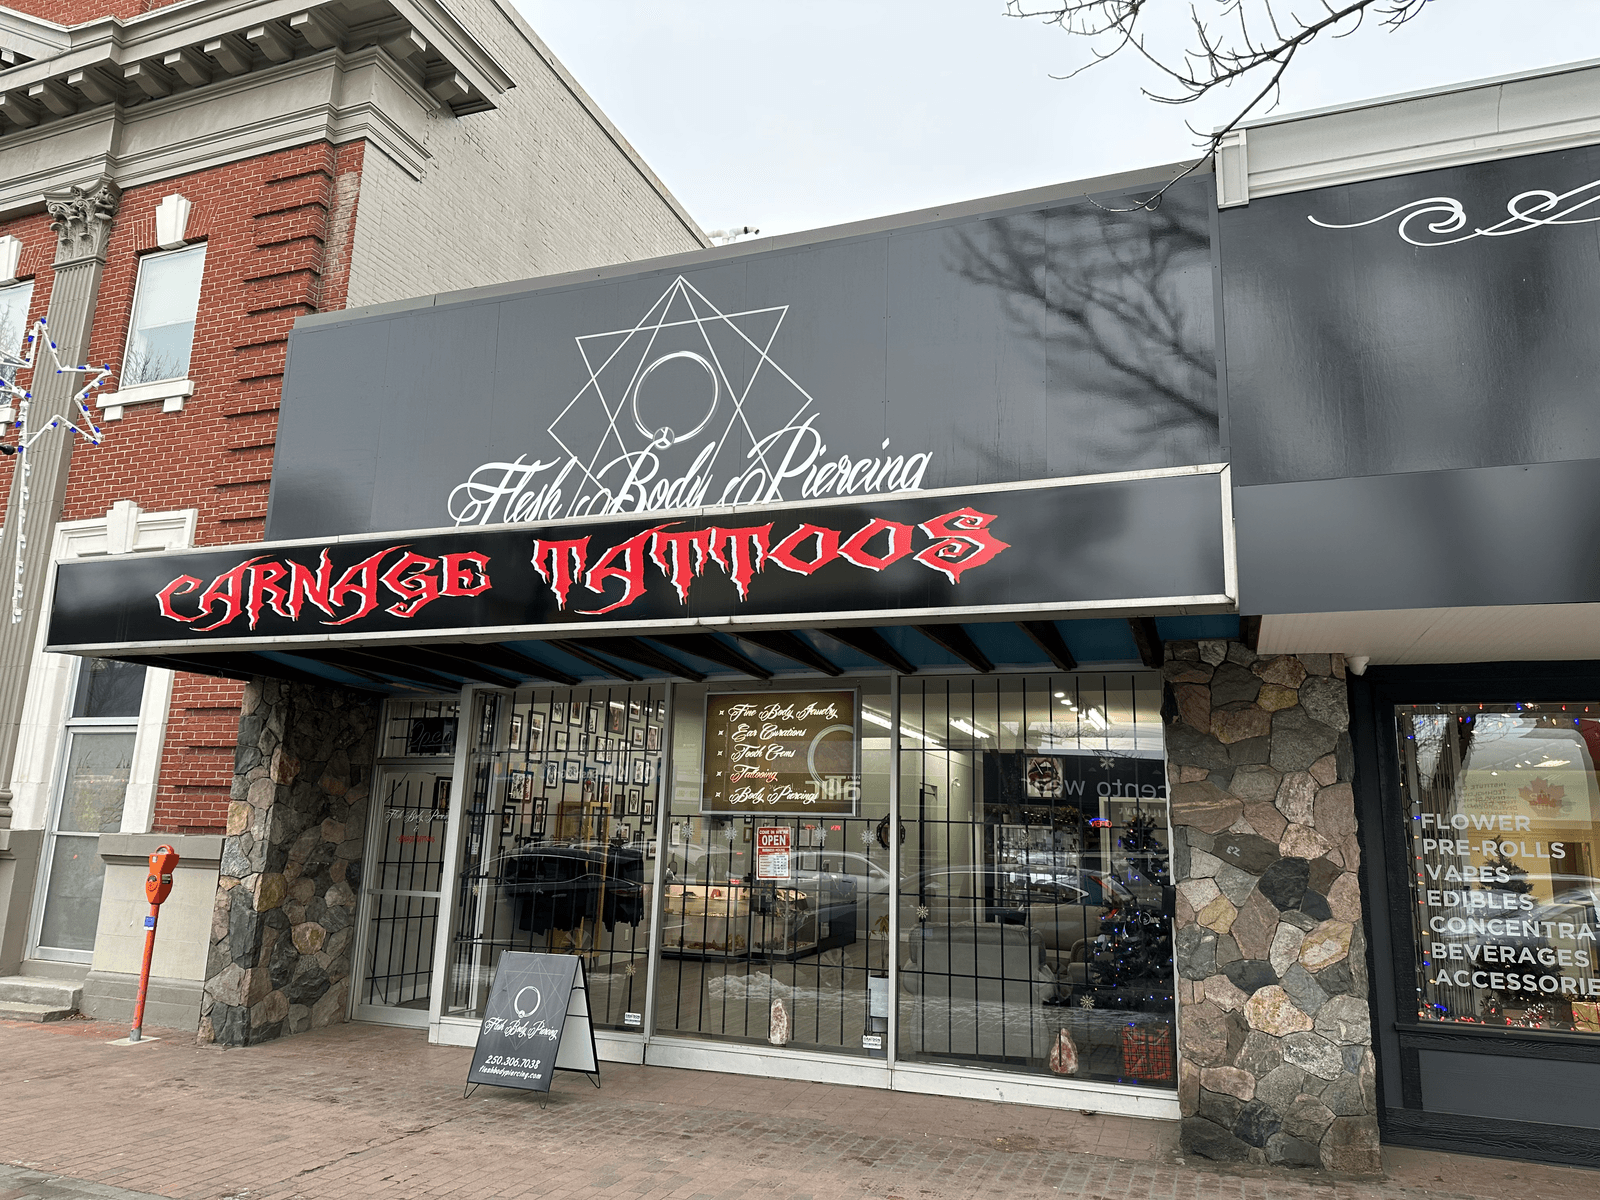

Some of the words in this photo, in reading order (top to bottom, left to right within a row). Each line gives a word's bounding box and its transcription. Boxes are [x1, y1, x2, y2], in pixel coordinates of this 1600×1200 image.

[447, 454, 577, 527] Flesh
[574, 441, 714, 516] Body
[722, 425, 933, 507] Piercing
[155, 544, 492, 631] CARNAGE
[531, 507, 1011, 614] TATTOOS
[728, 703, 758, 722] Fine
[759, 703, 794, 721] Body
[796, 702, 838, 720] Jewelry
[732, 723, 757, 742] Ear
[759, 723, 807, 740] Curations
[731, 744, 766, 762] Tooth
[765, 744, 797, 761] Gems
[730, 764, 778, 783] Tattooing
[729, 786, 764, 804] Body
[1420, 812, 1531, 832] FLOWER
[762, 835, 786, 846] OPEN
[1423, 838, 1566, 859] PRE-ROLLS
[1425, 863, 1510, 884] VAPES
[1427, 889, 1534, 911] EDIBLES
[1429, 916, 1600, 941] CONCENTRA
[1431, 942, 1590, 967] BEVERAGES
[1435, 968, 1600, 996] ACCESSORIE
[485, 1054, 541, 1070] 250.306.7038
